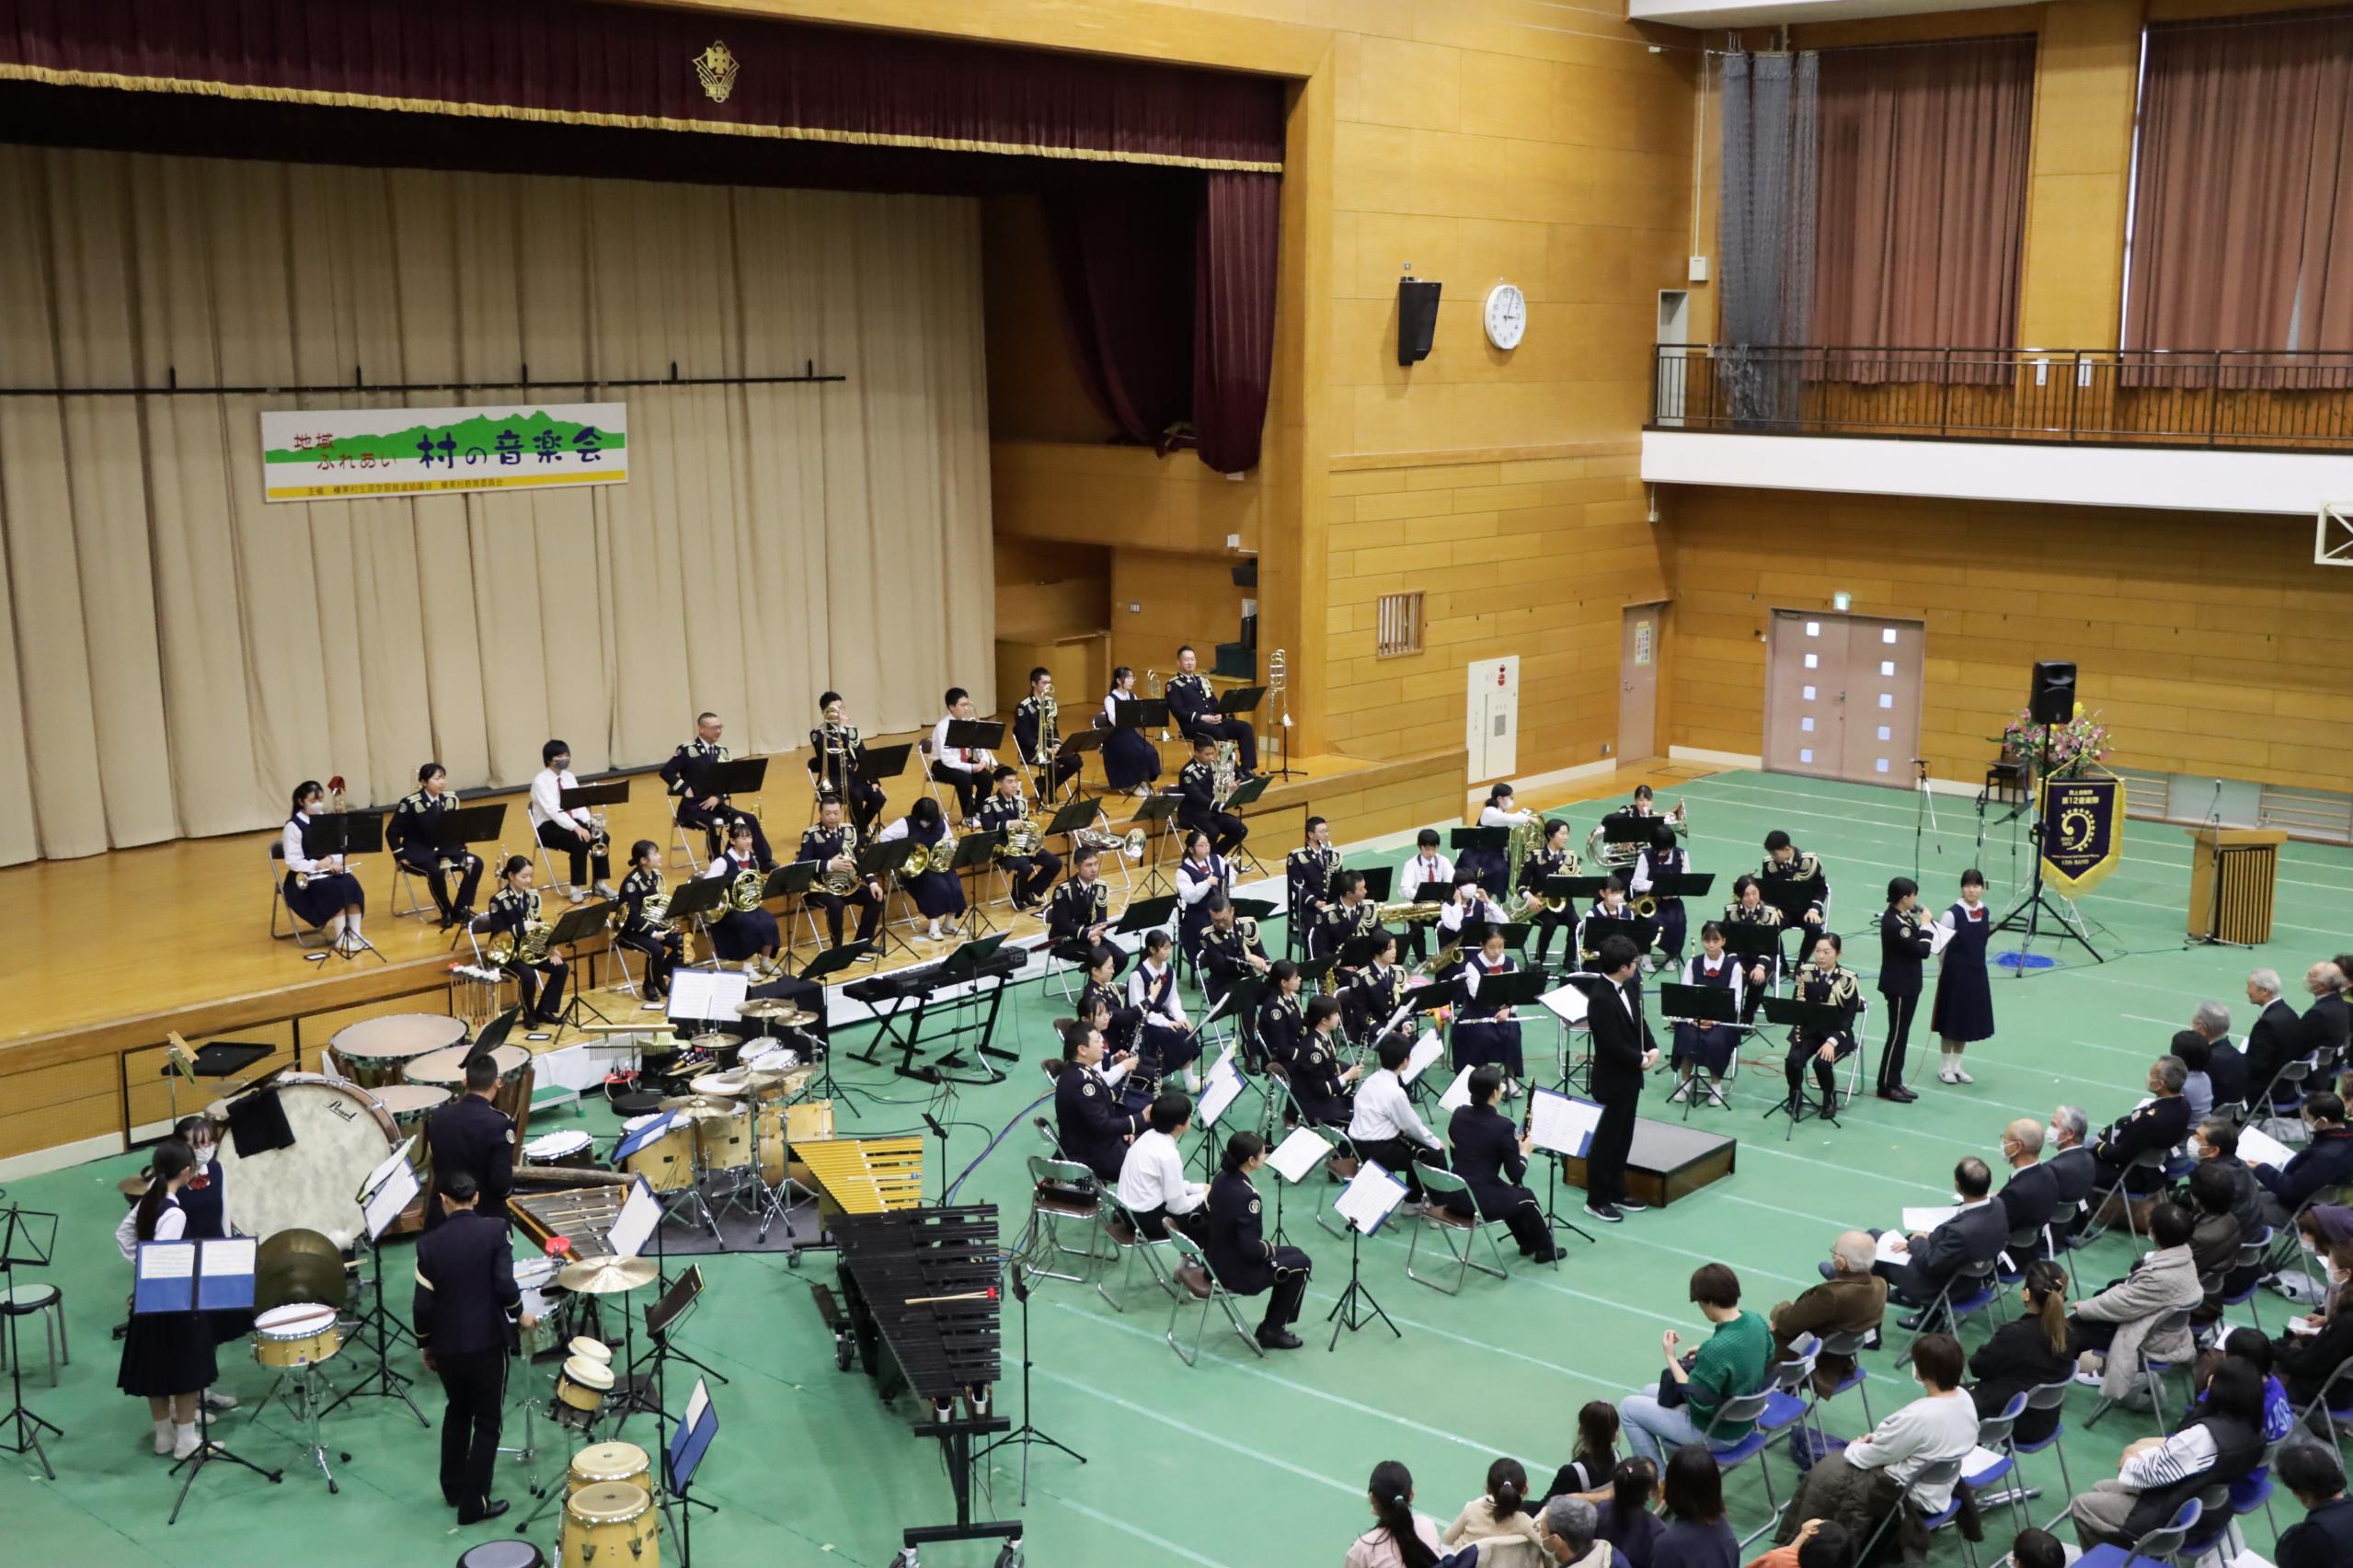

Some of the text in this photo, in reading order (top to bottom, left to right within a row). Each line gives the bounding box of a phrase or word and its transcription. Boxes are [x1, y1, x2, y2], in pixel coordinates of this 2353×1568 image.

[294, 432, 335, 451] 地域
[417, 426, 603, 469] 村の音楽会
[316, 451, 397, 471] ふれあい
[323, 1100, 358, 1121] Pearl
